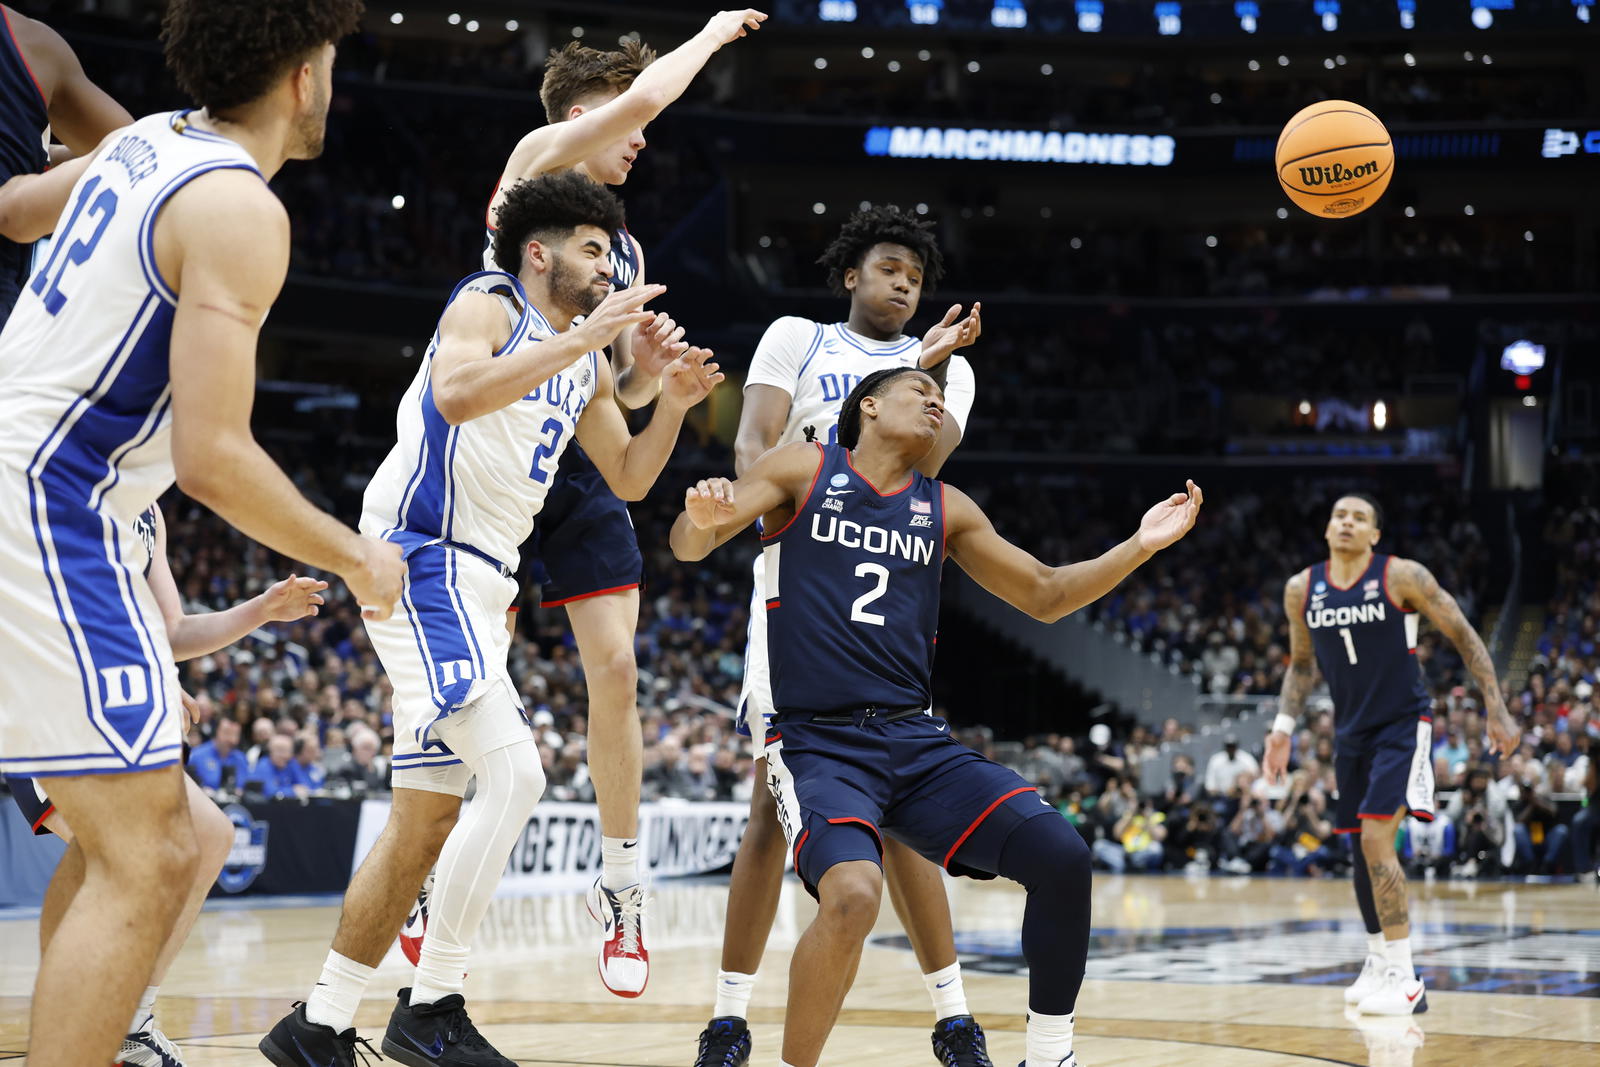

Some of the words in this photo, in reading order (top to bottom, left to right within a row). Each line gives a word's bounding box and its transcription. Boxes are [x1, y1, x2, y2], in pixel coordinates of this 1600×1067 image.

[105, 136, 158, 190] BOOZER
[865, 126, 1176, 166] #MARCHMADNESS
[1299, 160, 1378, 186] Wilson
[30, 175, 119, 317] 12
[529, 417, 564, 484] 2
[811, 513, 935, 566] UCONN
[850, 562, 890, 627] 2
[1306, 602, 1386, 629] UCONN
[1339, 628, 1358, 665] 1
[99, 664, 149, 709] D
